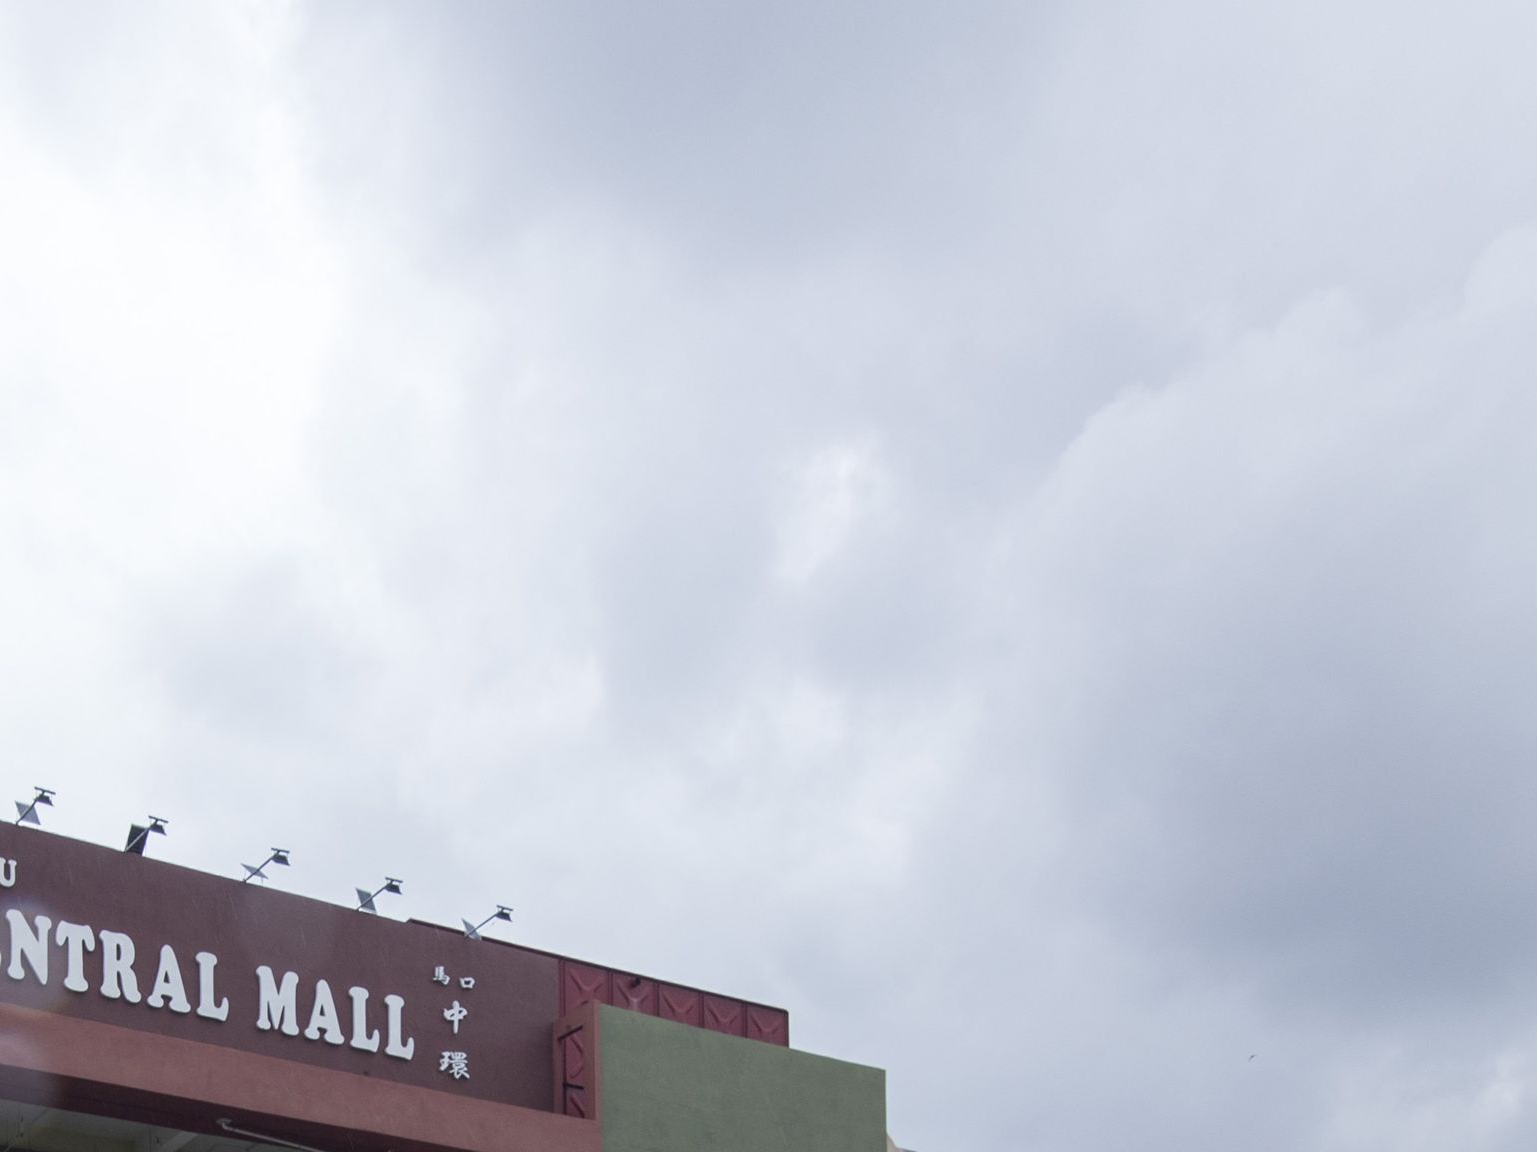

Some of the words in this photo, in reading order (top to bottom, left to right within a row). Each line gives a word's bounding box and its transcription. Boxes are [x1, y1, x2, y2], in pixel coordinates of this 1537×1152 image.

[255, 965, 414, 1060] MALL
[433, 965, 475, 989] 馬口
[439, 1000, 470, 1080] 中環
